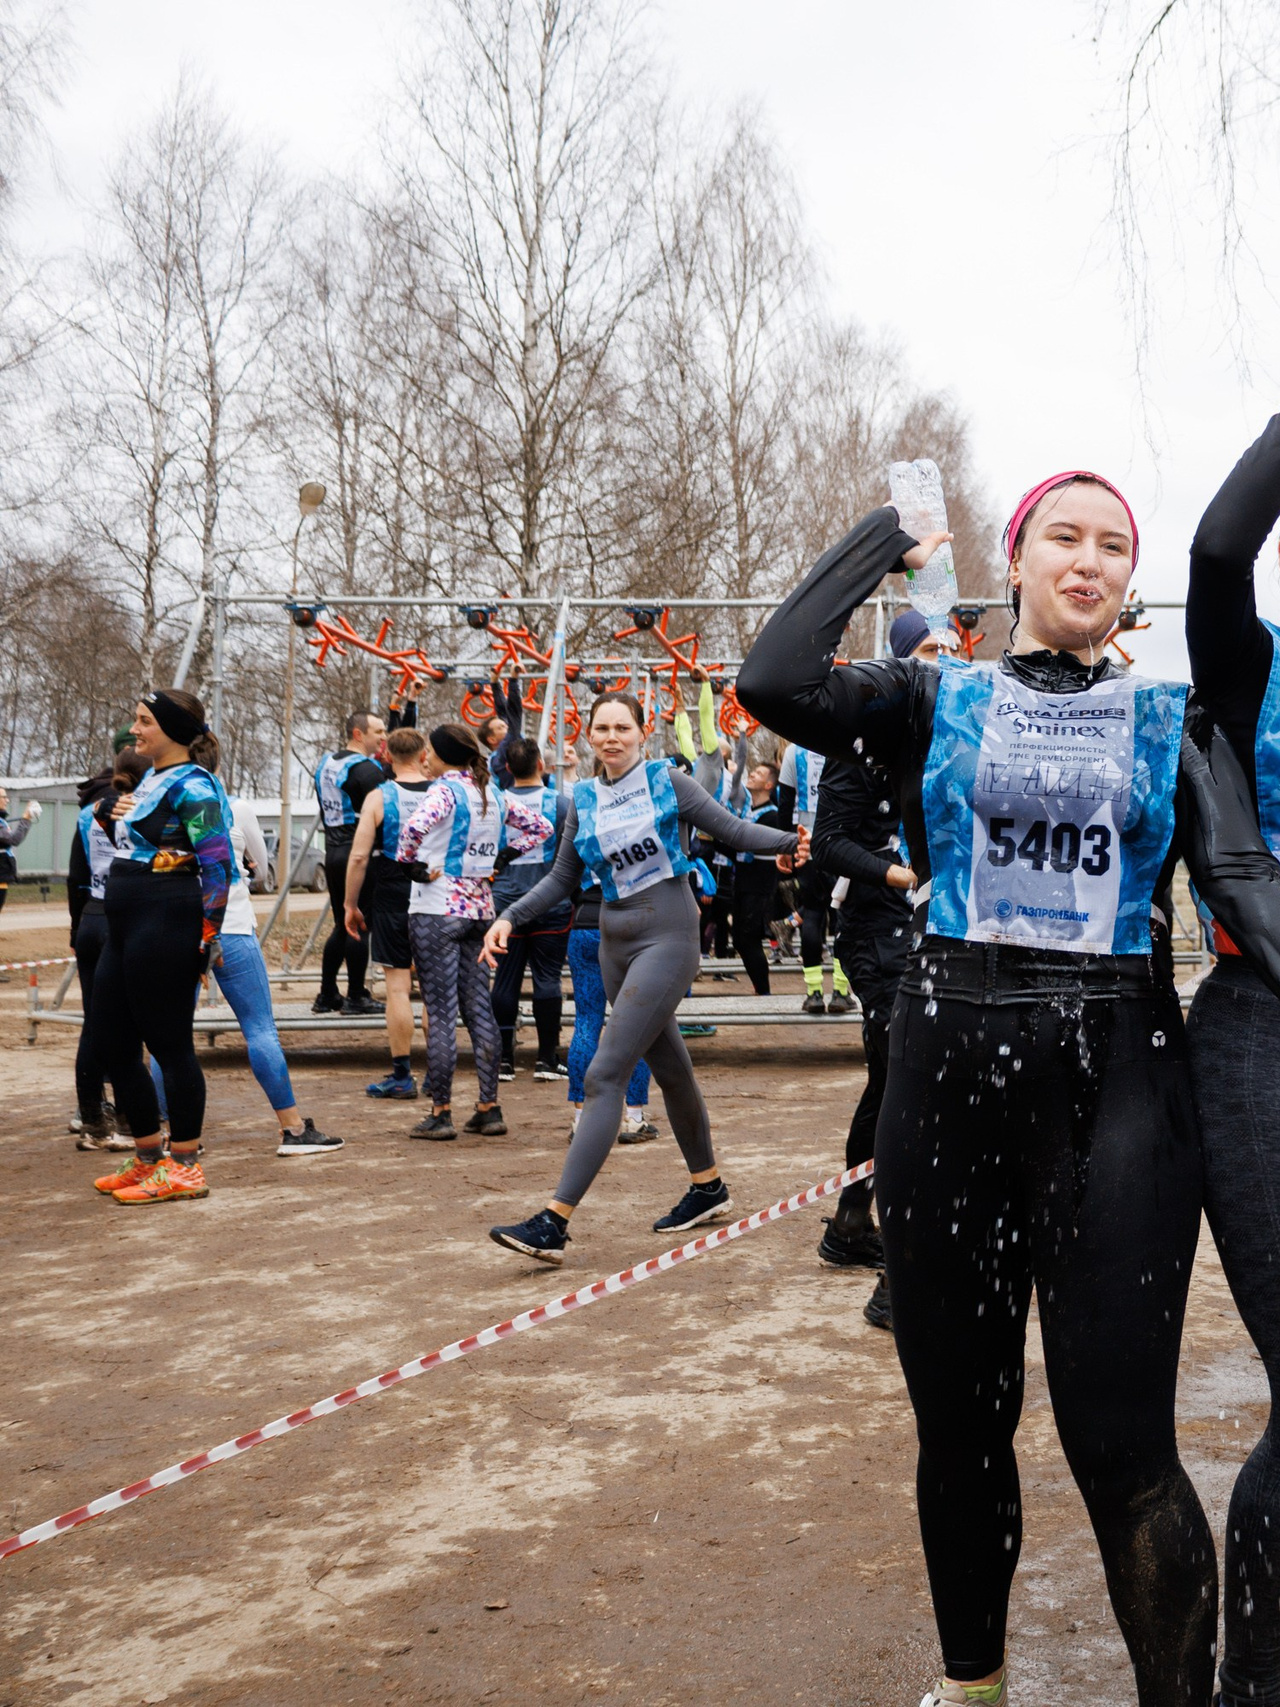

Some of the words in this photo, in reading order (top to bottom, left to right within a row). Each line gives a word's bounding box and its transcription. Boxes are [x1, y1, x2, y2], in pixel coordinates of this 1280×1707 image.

[1058, 708, 1126, 718] ГЕРОЕВ
[1012, 717, 1106, 738] Sminex
[1009, 742, 1107, 754] ПЕРФЕКЦИОНИСТЫ
[1008, 752, 1030, 760] FINE
[1034, 754, 1106, 764] DEVELOPMENT
[609, 837, 659, 871] 5189
[987, 817, 1111, 876] 5403
[1016, 905, 1089, 922] ГАЗПРОМБАНК
